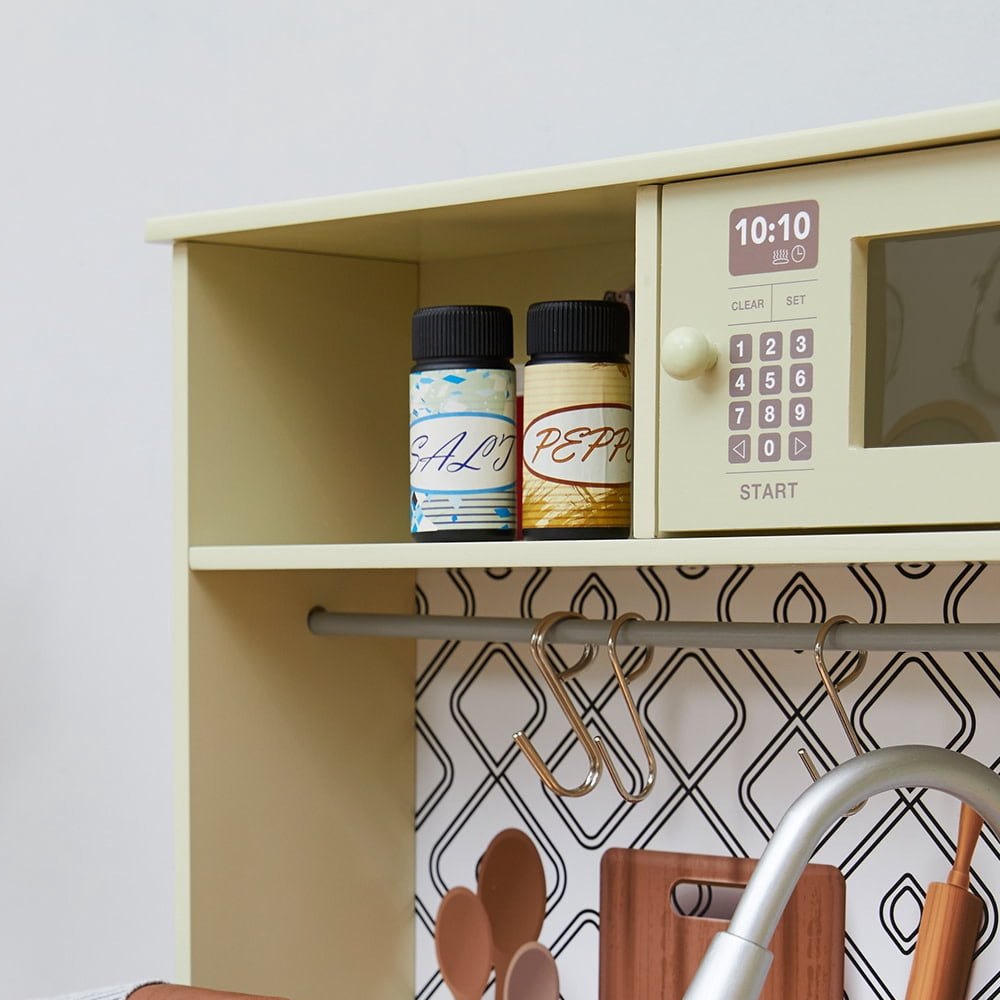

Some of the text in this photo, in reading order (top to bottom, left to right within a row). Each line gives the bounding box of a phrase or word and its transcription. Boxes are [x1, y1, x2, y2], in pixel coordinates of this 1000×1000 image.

[735, 210, 811, 246] 10:10
[731, 298, 765, 312] CLEAR
[786, 294, 806, 306] SET
[735, 335, 807, 358] 1 2 3
[735, 370, 806, 391] 4 5 6
[735, 404, 806, 425] 7 8 9
[764, 440, 775, 456] 0
[740, 482, 799, 501] START
